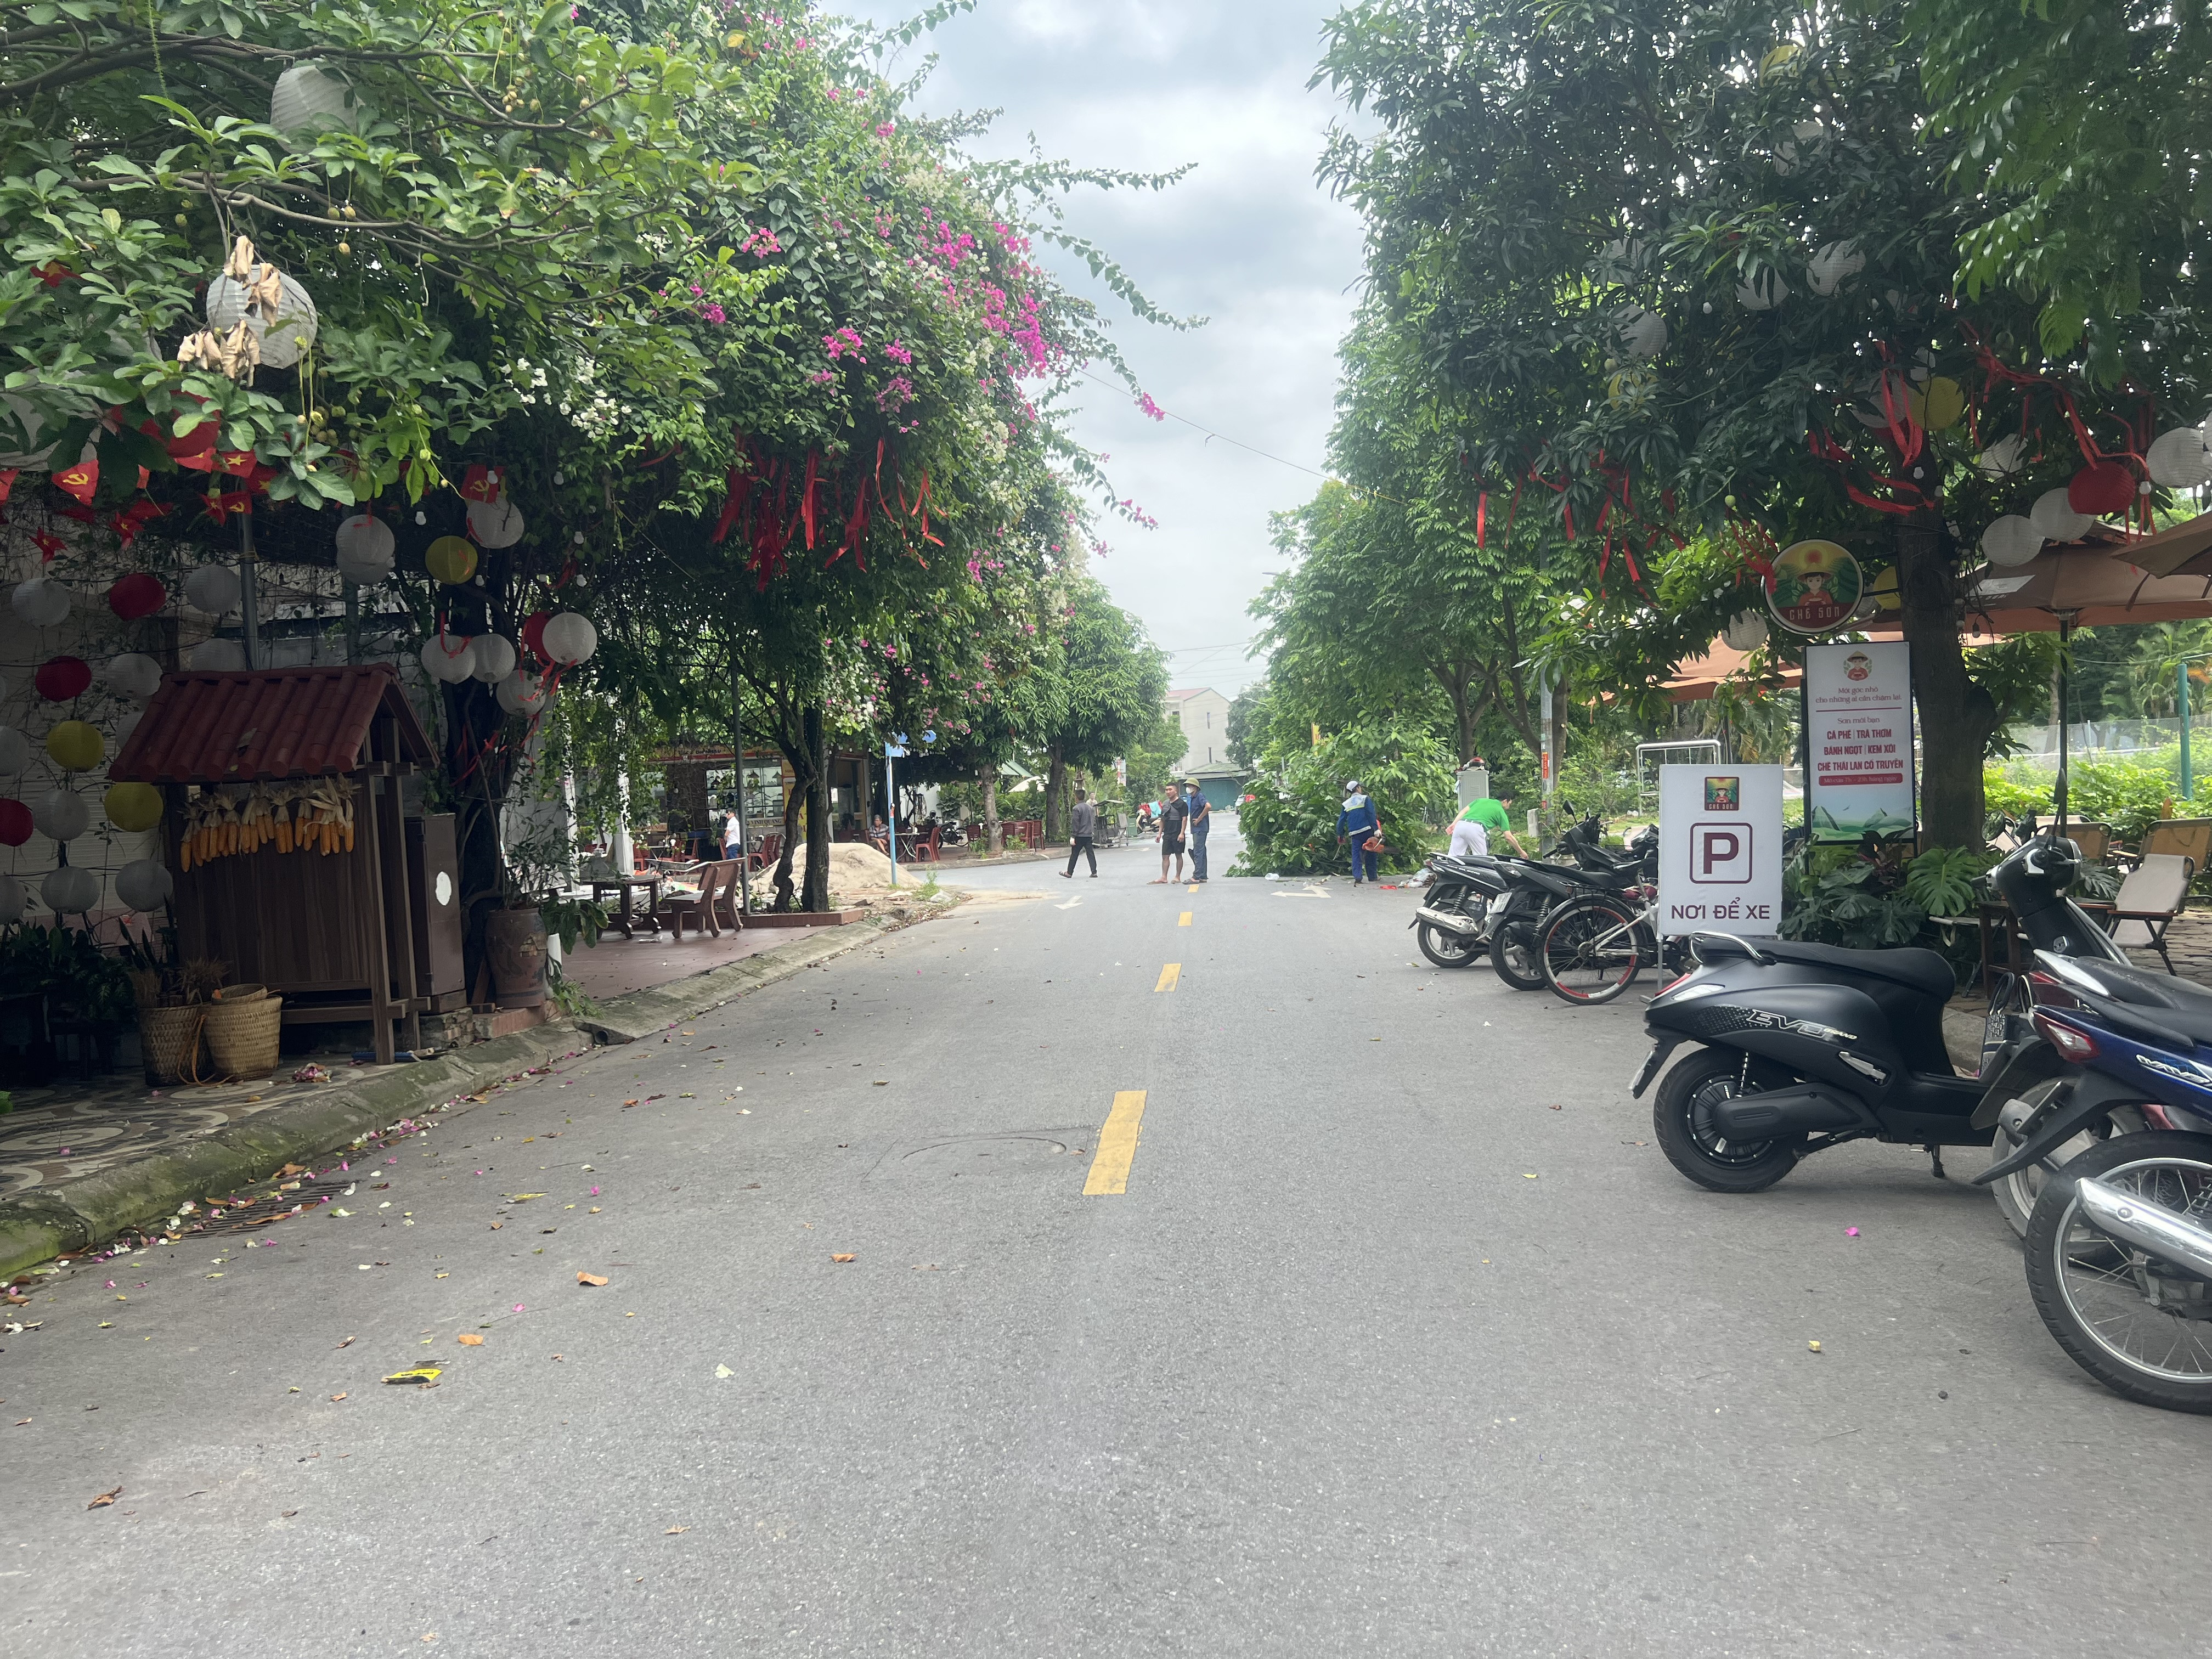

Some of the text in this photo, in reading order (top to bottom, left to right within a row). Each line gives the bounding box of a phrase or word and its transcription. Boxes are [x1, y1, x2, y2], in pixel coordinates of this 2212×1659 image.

[1838, 729, 1852, 739] PHÊ
[1871, 728, 1892, 738] THƠM
[1824, 745, 1843, 755] BÁNH
[1844, 746, 1862, 755] NGỌT
[1867, 744, 1882, 754] KEM
[1833, 760, 1848, 771] THÁI
[1850, 761, 1863, 770] LAN
[1876, 758, 1903, 769] TRUYỀN
[1703, 832, 1739, 874] P
[1671, 897, 1770, 919] NƠI ĐỂ XE
[1746, 1009, 1858, 1040] EVO GRAND
